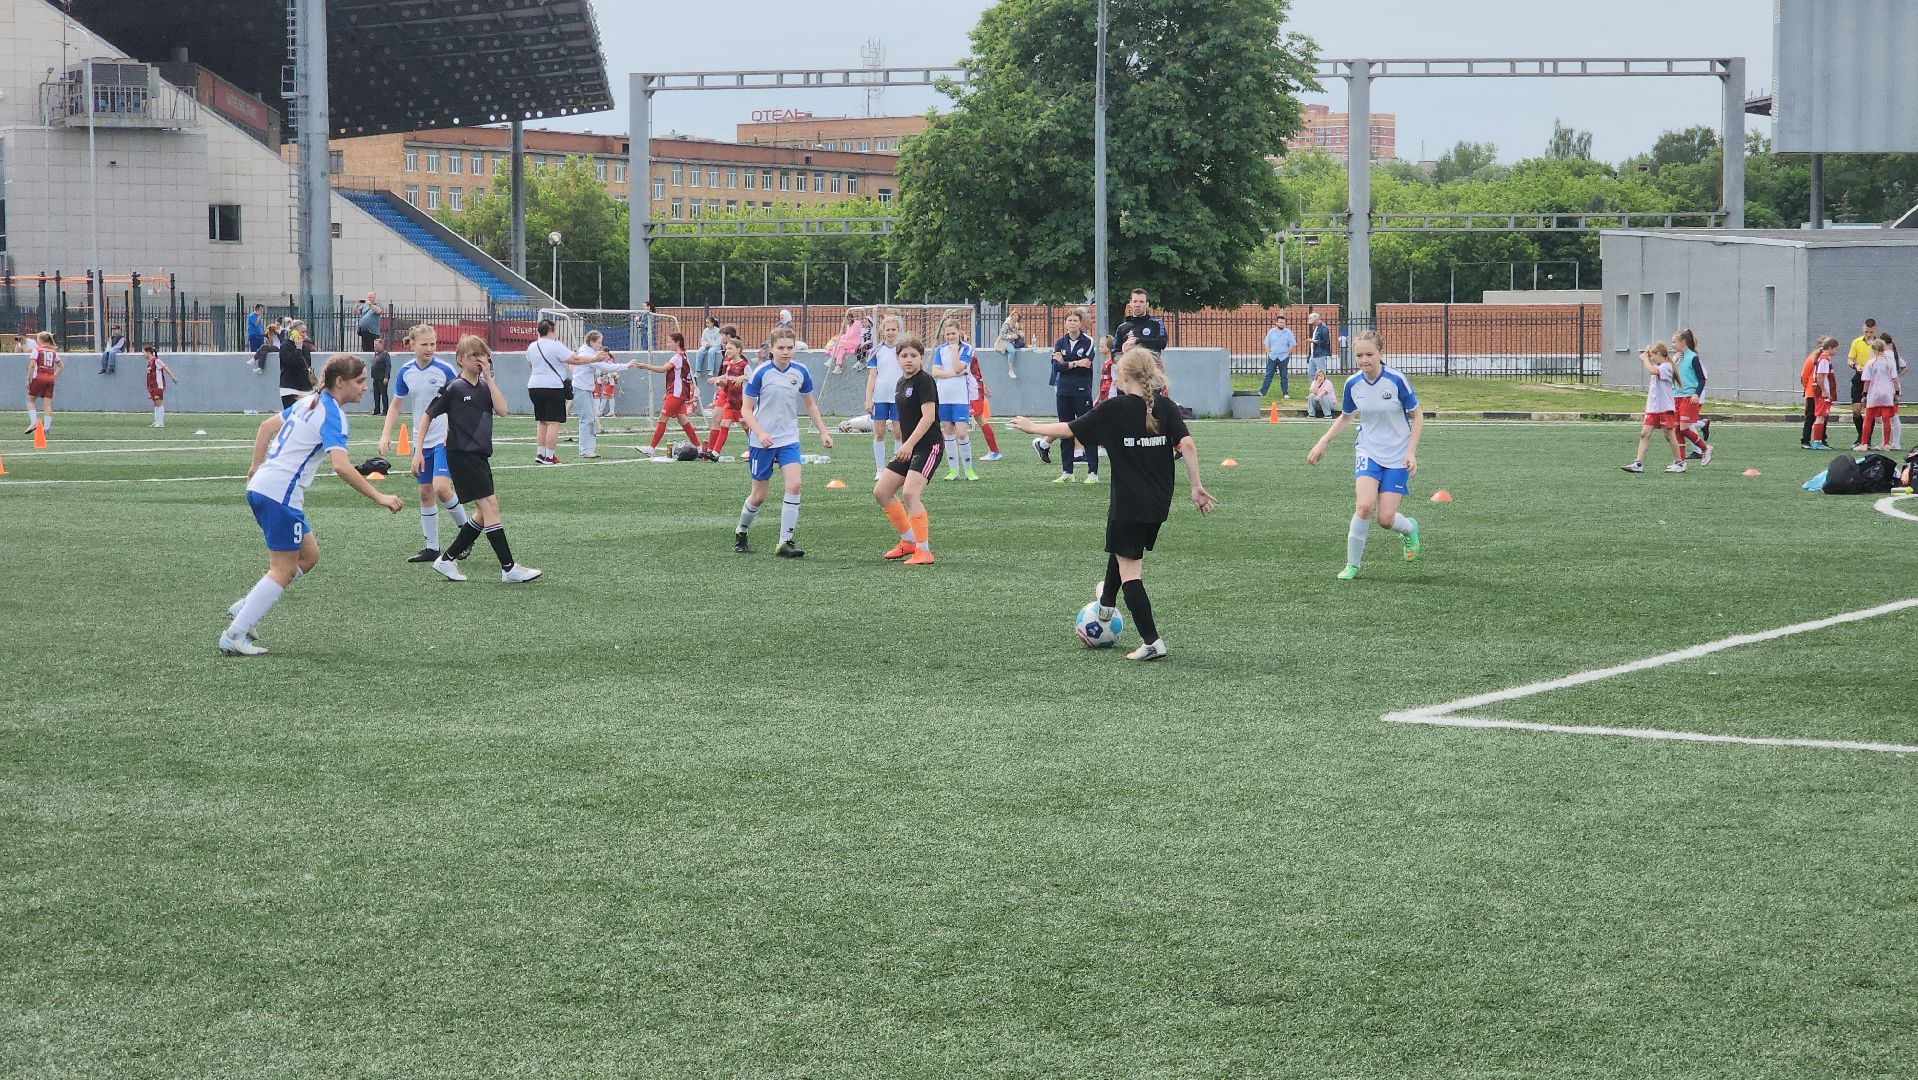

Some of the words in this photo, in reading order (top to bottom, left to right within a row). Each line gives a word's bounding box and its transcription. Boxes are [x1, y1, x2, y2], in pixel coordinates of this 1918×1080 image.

[751, 108, 805, 121] ОТЕЛЬ
[43, 350, 54, 367] 19
[269, 420, 295, 459] 9
[293, 521, 303, 544] 9
